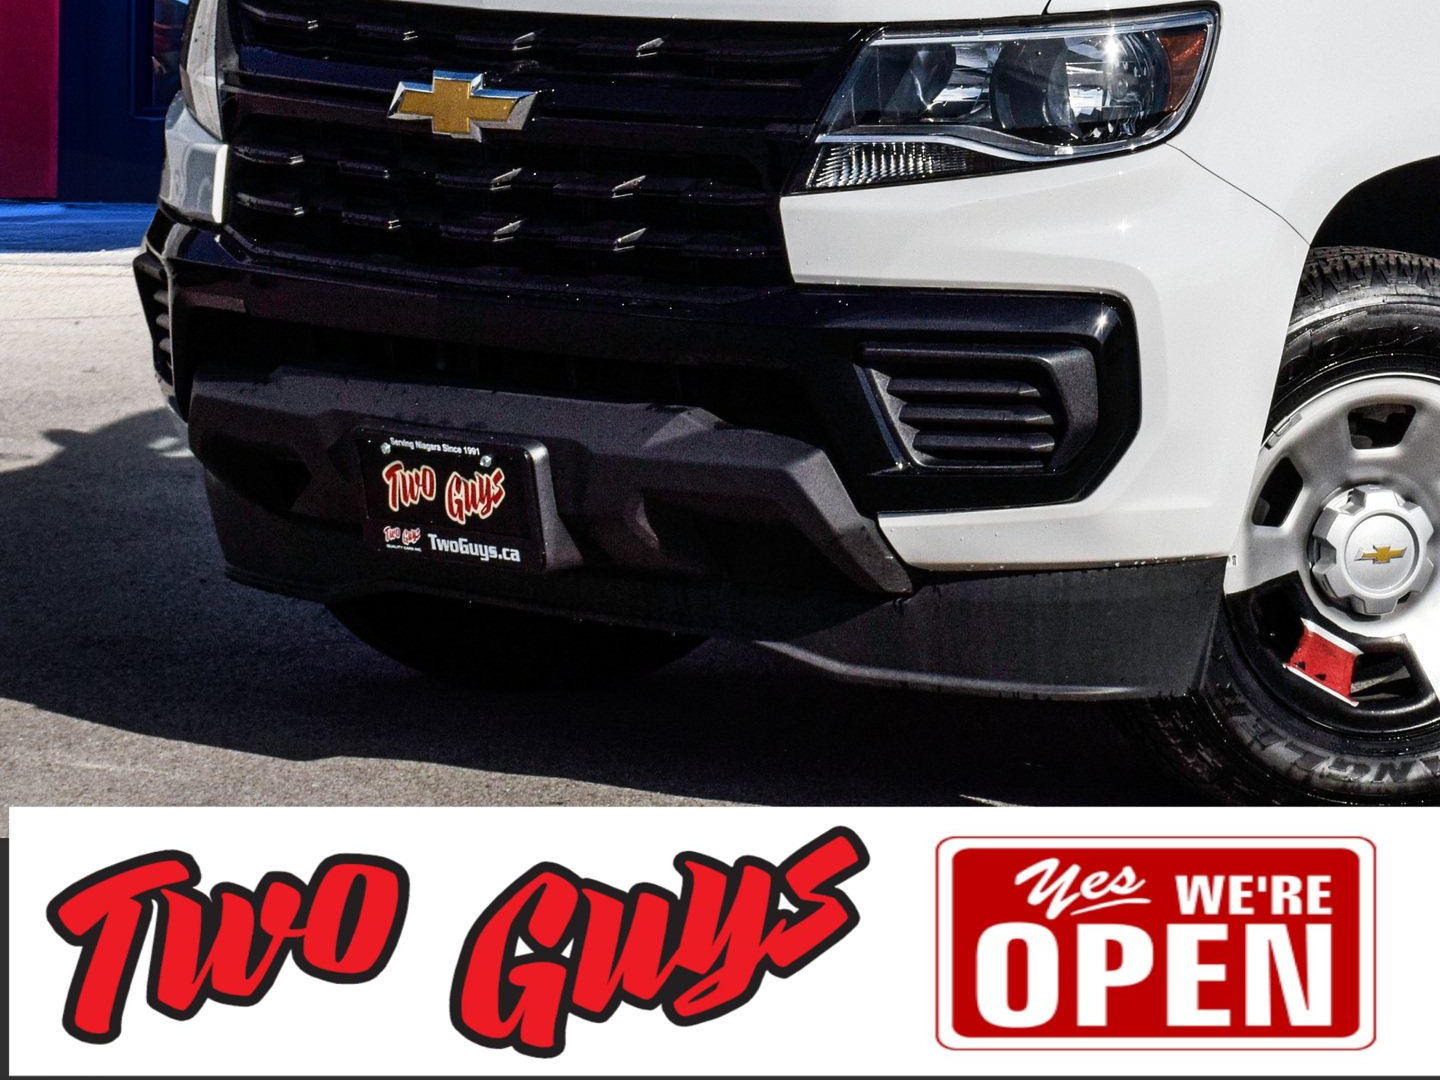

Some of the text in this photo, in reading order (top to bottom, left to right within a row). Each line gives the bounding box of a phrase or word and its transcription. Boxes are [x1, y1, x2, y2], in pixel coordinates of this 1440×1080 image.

[389, 436, 415, 450] Serving
[415, 440, 442, 453] Niagara
[442, 443, 463, 454] Since
[382, 460, 506, 525] Two Guys
[427, 533, 521, 563] TwoGuys.ca
